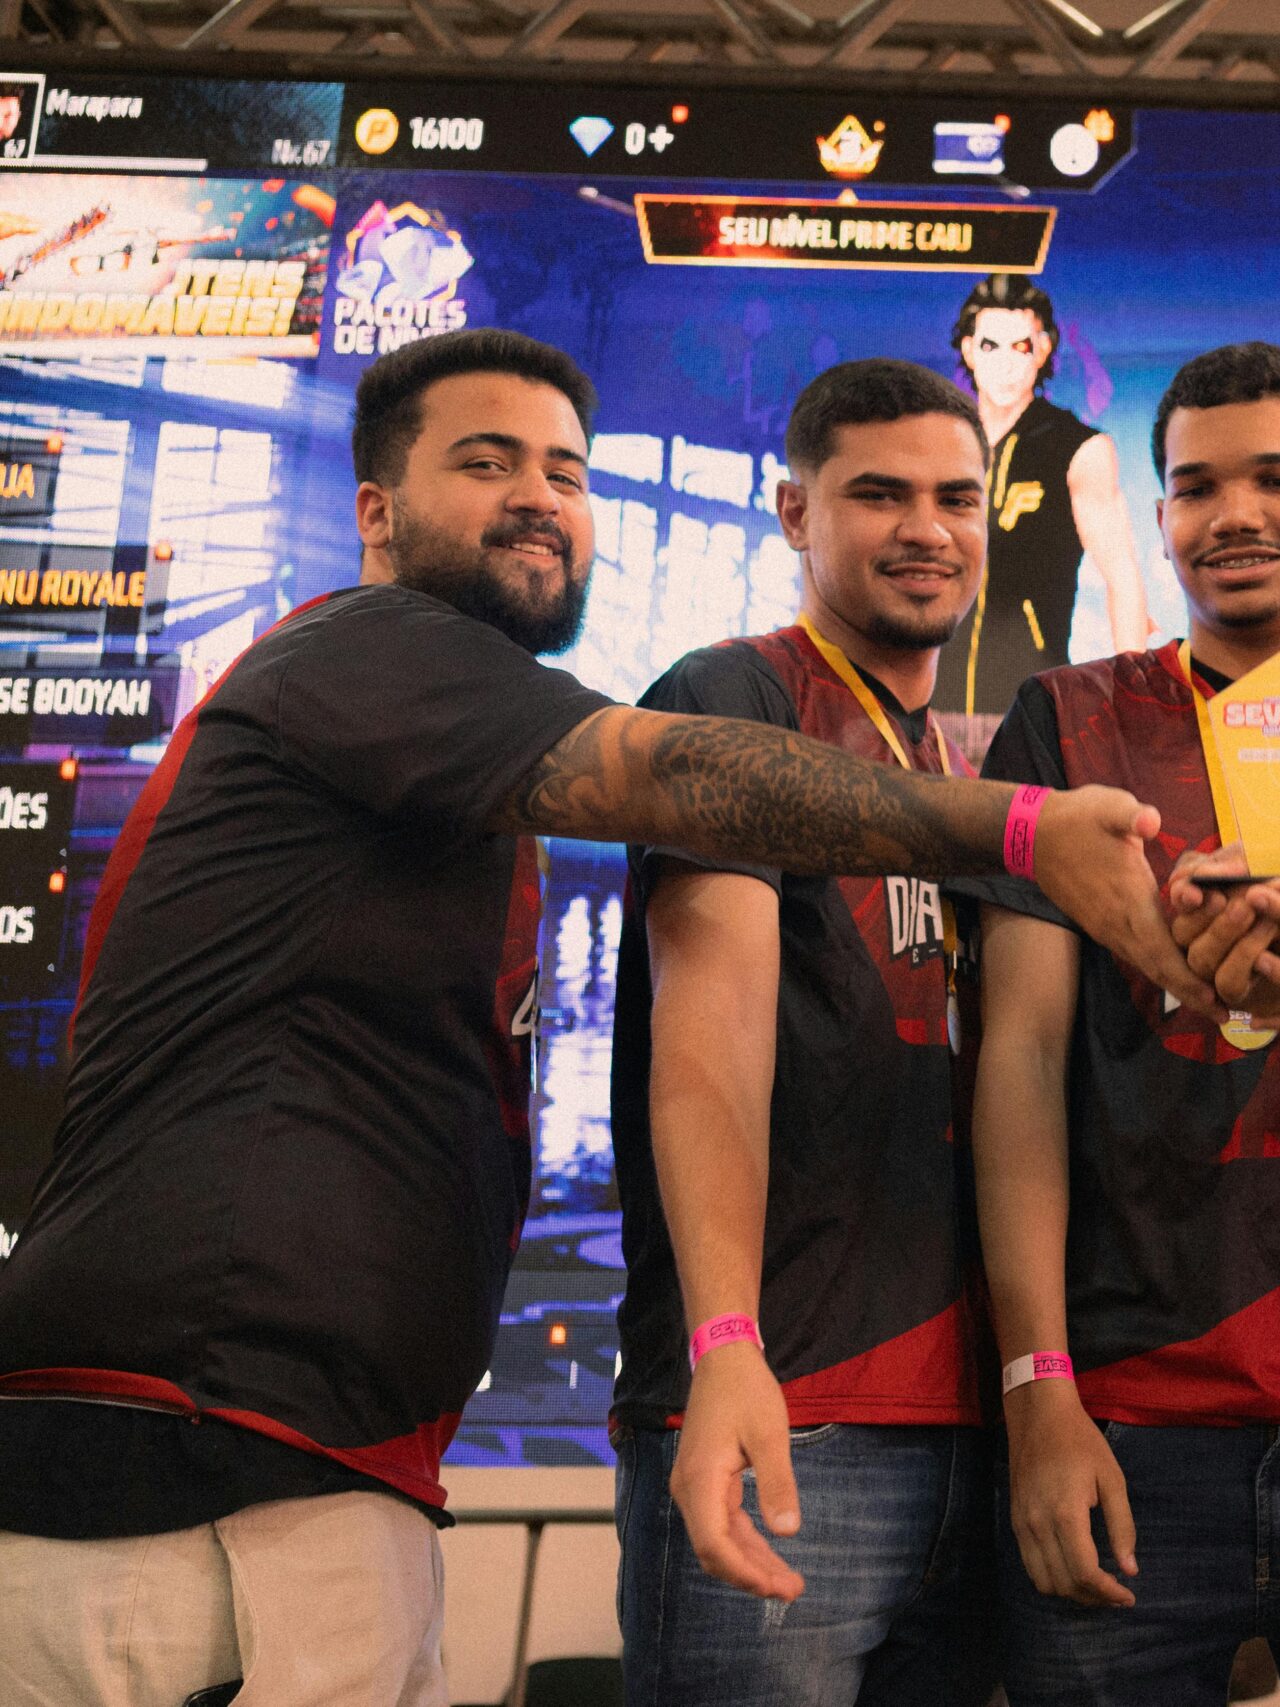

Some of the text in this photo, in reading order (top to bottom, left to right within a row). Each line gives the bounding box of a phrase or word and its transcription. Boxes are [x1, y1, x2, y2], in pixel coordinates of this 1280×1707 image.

[409, 116, 484, 150] 16100
[719, 216, 768, 247] SEU
[839, 220, 914, 250] PRIME
[334, 298, 467, 328] PACOTES
[333, 325, 376, 355] DE
[40, 570, 146, 606] ROYALE
[33, 678, 151, 717] BOOYAH
